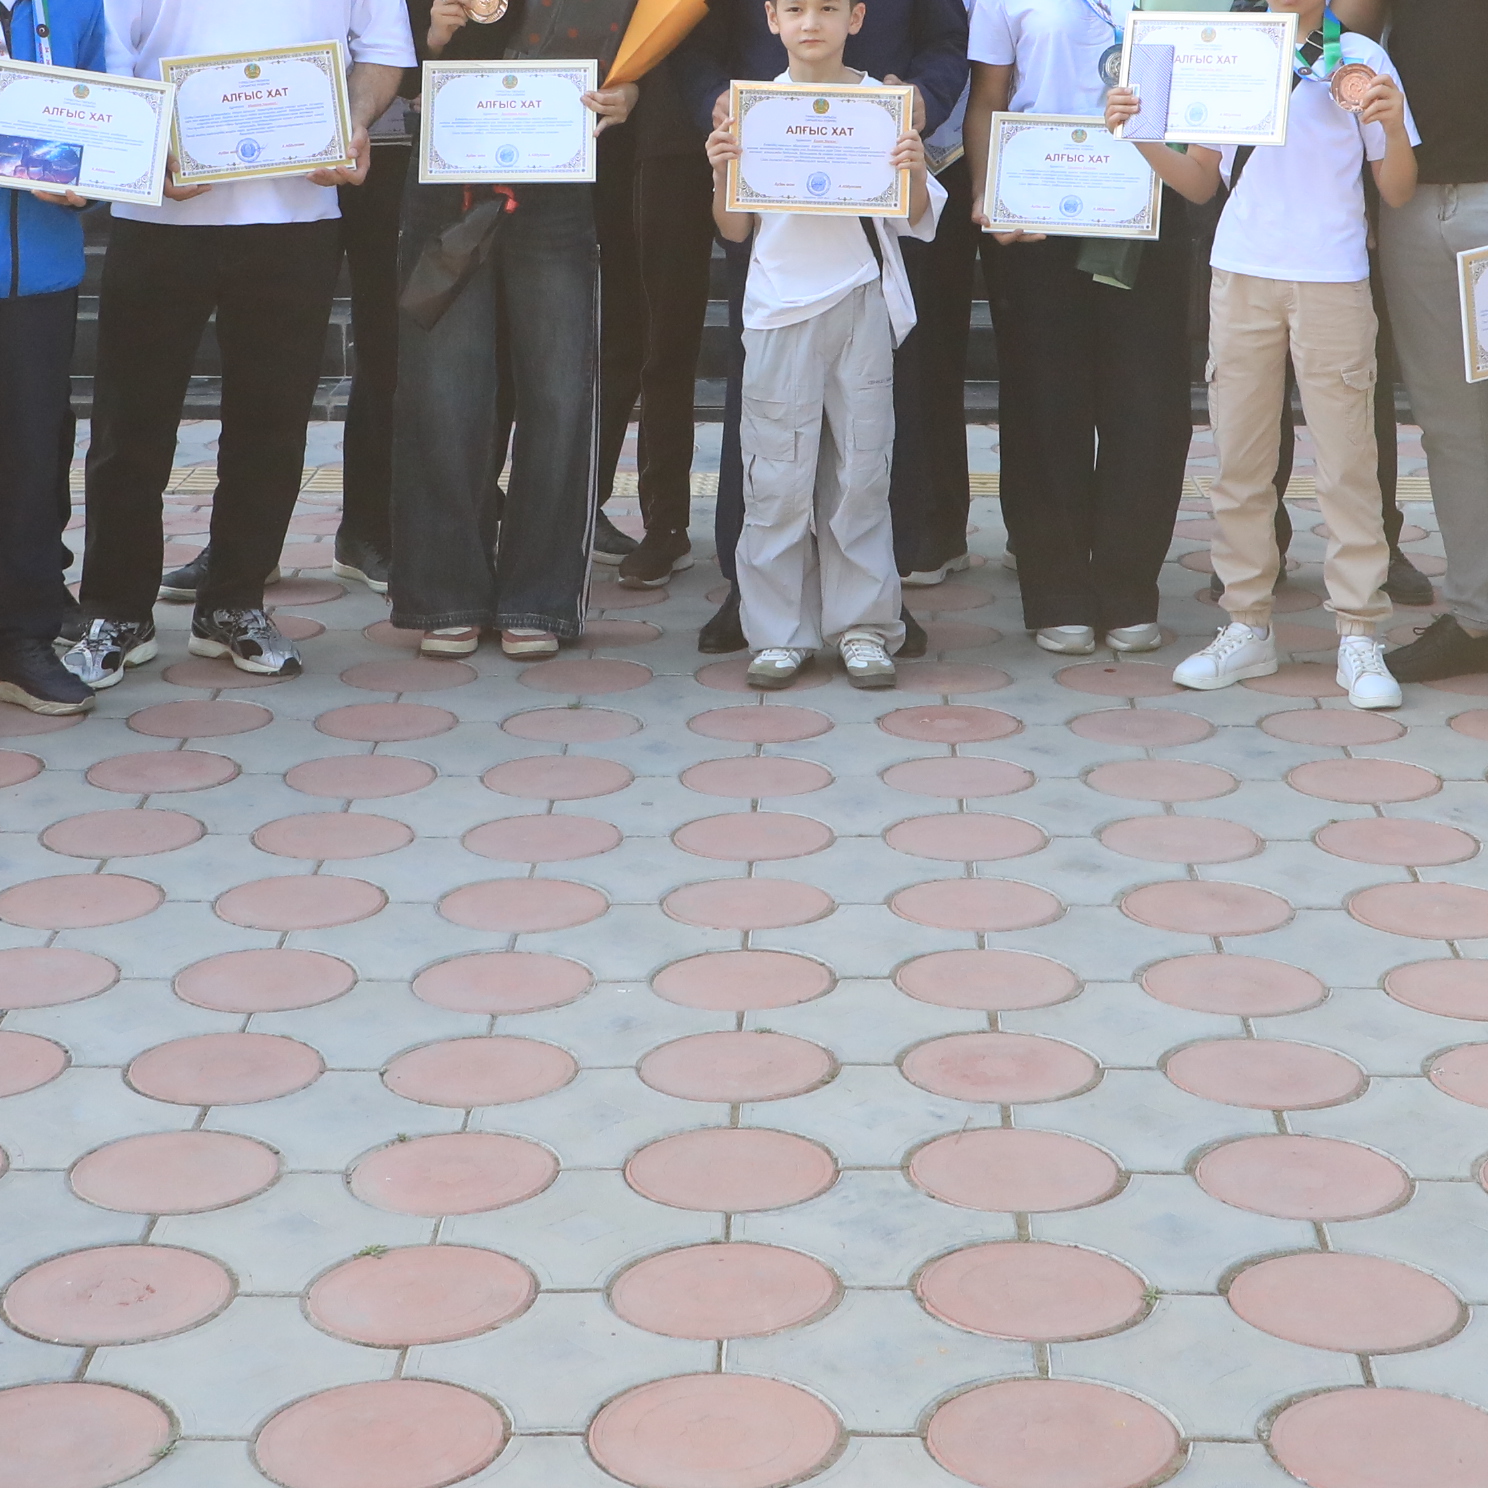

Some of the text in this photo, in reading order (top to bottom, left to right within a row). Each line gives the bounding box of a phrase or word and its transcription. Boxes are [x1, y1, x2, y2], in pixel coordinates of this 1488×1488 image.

[1216, 55, 1238, 64] ХАТ
[222, 88, 289, 103] АЛҒЫС ХАТ
[477, 100, 542, 109] АЛҒЫС ХАТ
[42, 106, 113, 123] АЛҒЫС ХАТ
[786, 126, 854, 136] АЛҒЫС ХАТ
[1045, 153, 1110, 163] АЛҒЫС ХАТ
